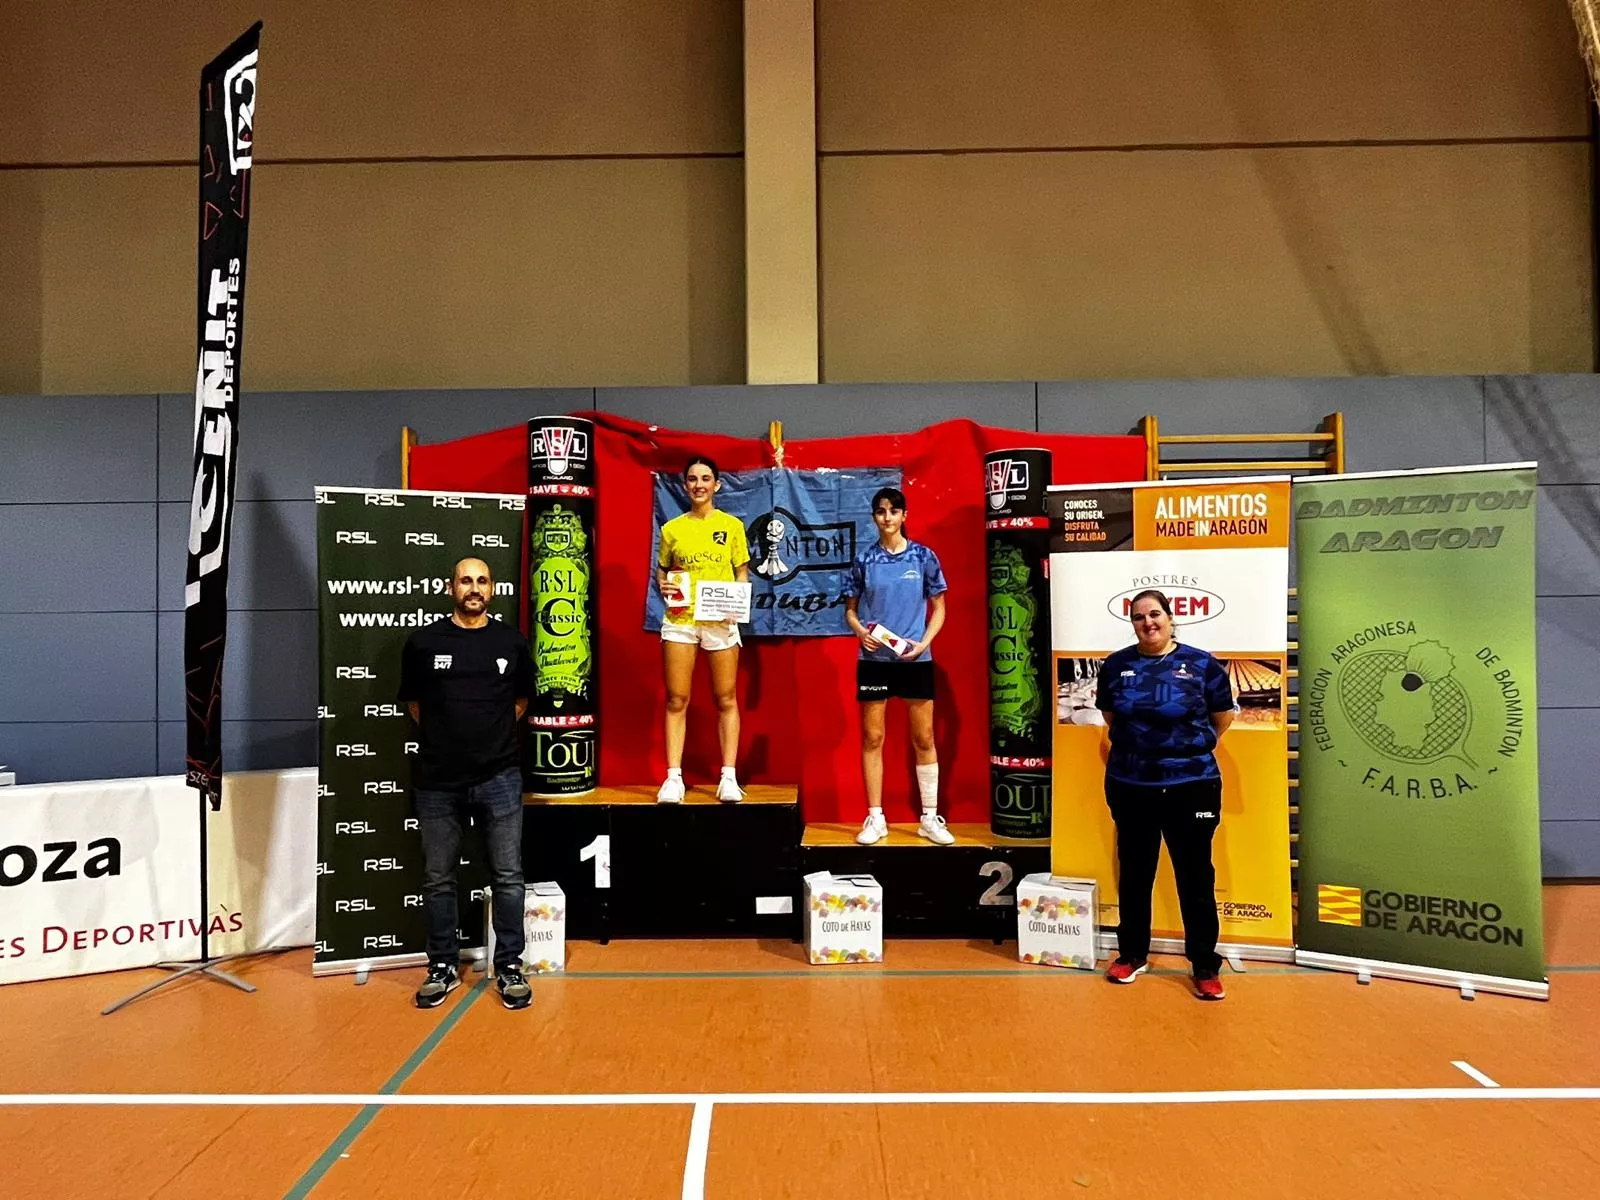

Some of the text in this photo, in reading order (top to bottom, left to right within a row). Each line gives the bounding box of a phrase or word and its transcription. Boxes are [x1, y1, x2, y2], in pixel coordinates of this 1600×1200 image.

[224, 257, 240, 402] DEPORTES
[533, 484, 558, 494] SAVE
[364, 493, 405, 507] RSL
[432, 496, 472, 509] RSL
[499, 499, 525, 511] RS
[1064, 499, 1097, 509] CONOCES
[1155, 493, 1267, 519] ALIMENTOS
[1296, 489, 1534, 520] BADMINTON
[1010, 517, 1033, 527] 40%
[1064, 511, 1074, 520] SU
[1064, 521, 1099, 531] DISFRUTA
[336, 531, 377, 544] RSL
[405, 532, 444, 546] RSL
[471, 534, 510, 548] RSL
[1064, 532, 1106, 541] SU CALIDAD
[1319, 525, 1505, 554] ARAGON
[1132, 574, 1199, 587] POSTRES
[701, 586, 734, 599] RSL
[336, 667, 376, 679] RSL
[1310, 620, 1524, 758] FEDERACION ARAGONESA DE BADMINTON
[364, 704, 404, 717] RSL
[336, 744, 376, 756] RSL
[1022, 757, 1045, 767] 40%
[364, 781, 404, 794] RSL
[336, 822, 376, 834] RSL
[363, 858, 403, 871] RSL
[580, 835, 611, 888] 1
[979, 861, 1014, 906] 2
[335, 899, 376, 912] RSL
[1223, 902, 1266, 912] GOBIERNO
[1365, 889, 1503, 922] GOBIERNO
[1237, 910, 1273, 919] ARAGON
[822, 921, 840, 932] COTO
[850, 920, 872, 931] HAYAS
[1028, 920, 1047, 933] COTO
[1058, 923, 1081, 936] HAYAS
[1363, 909, 1524, 947] DE ARAGON
[363, 935, 403, 949] RSL
[531, 929, 553, 943] HAYAS
